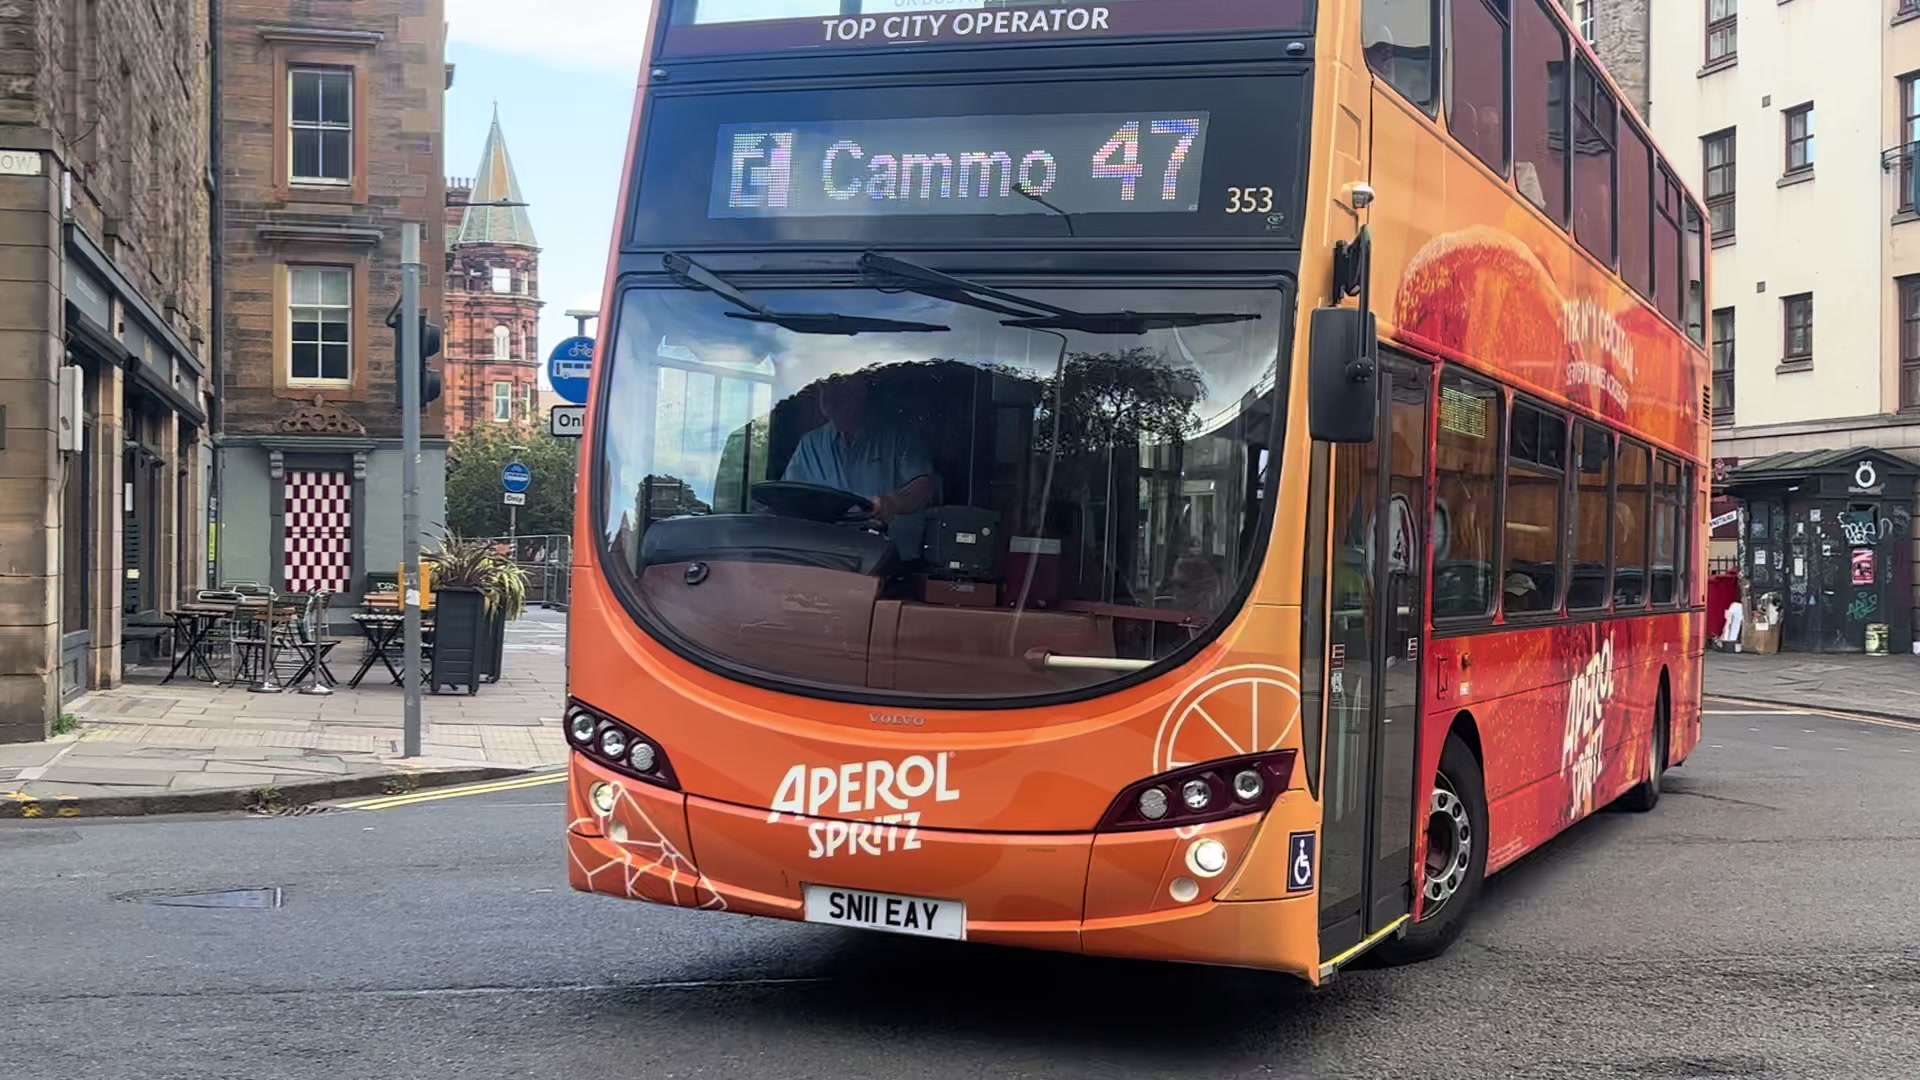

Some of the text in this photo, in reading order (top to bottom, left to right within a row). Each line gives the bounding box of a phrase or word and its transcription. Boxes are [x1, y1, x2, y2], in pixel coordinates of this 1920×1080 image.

[822, 7, 1109, 41] TOP CITY OPERATOR
[822, 118, 1200, 201] Cammo 47
[1225, 186, 1273, 213] 353
[559, 414, 584, 427] Onl
[869, 713, 926, 726] VOLVO
[1560, 628, 1616, 777] APEROL
[767, 752, 959, 823] APEROL
[808, 811, 921, 858] SPRITZ
[829, 892, 938, 930] SN11 EAY
